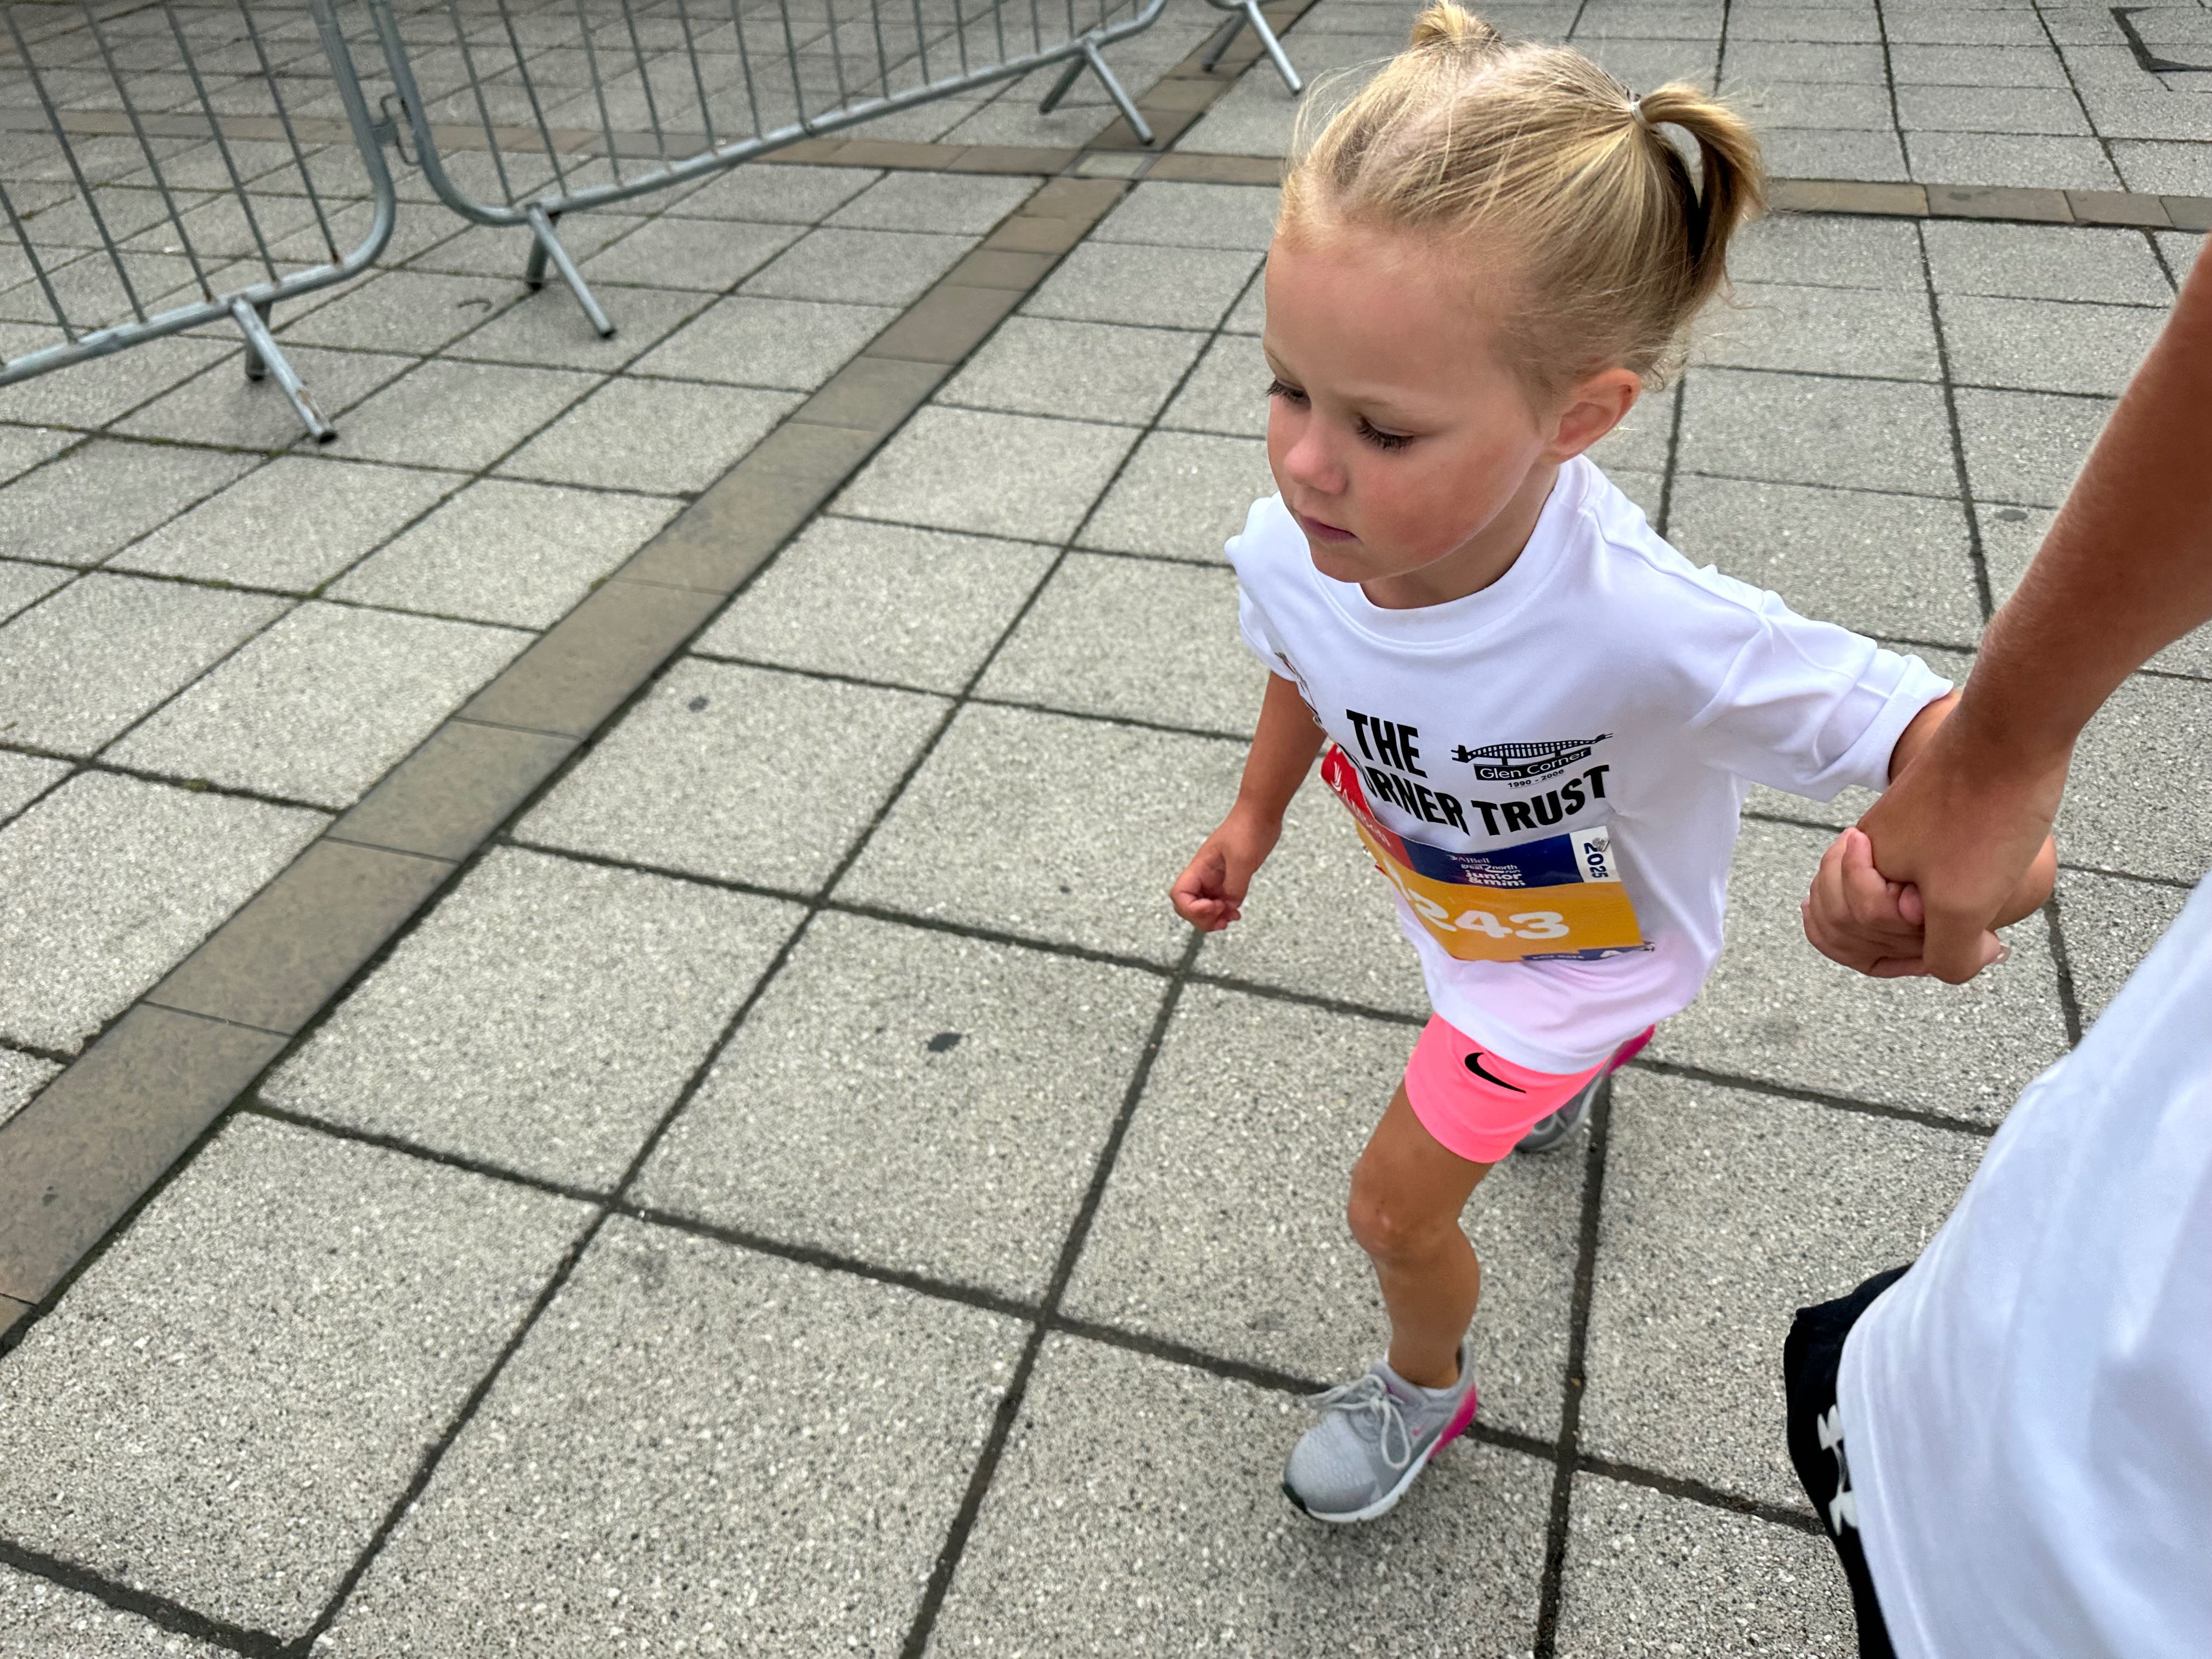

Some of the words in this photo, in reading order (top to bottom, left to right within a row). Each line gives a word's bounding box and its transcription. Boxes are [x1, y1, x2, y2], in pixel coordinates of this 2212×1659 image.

[1346, 709, 1427, 778] THE
[1480, 768, 1521, 778] Glen
[1527, 749, 1588, 774] Corner
[1508, 779, 1531, 788] 1990
[1471, 764, 1610, 836] TRUST
[1465, 870, 1522, 879] junior
[1583, 842, 1609, 878] 2025
